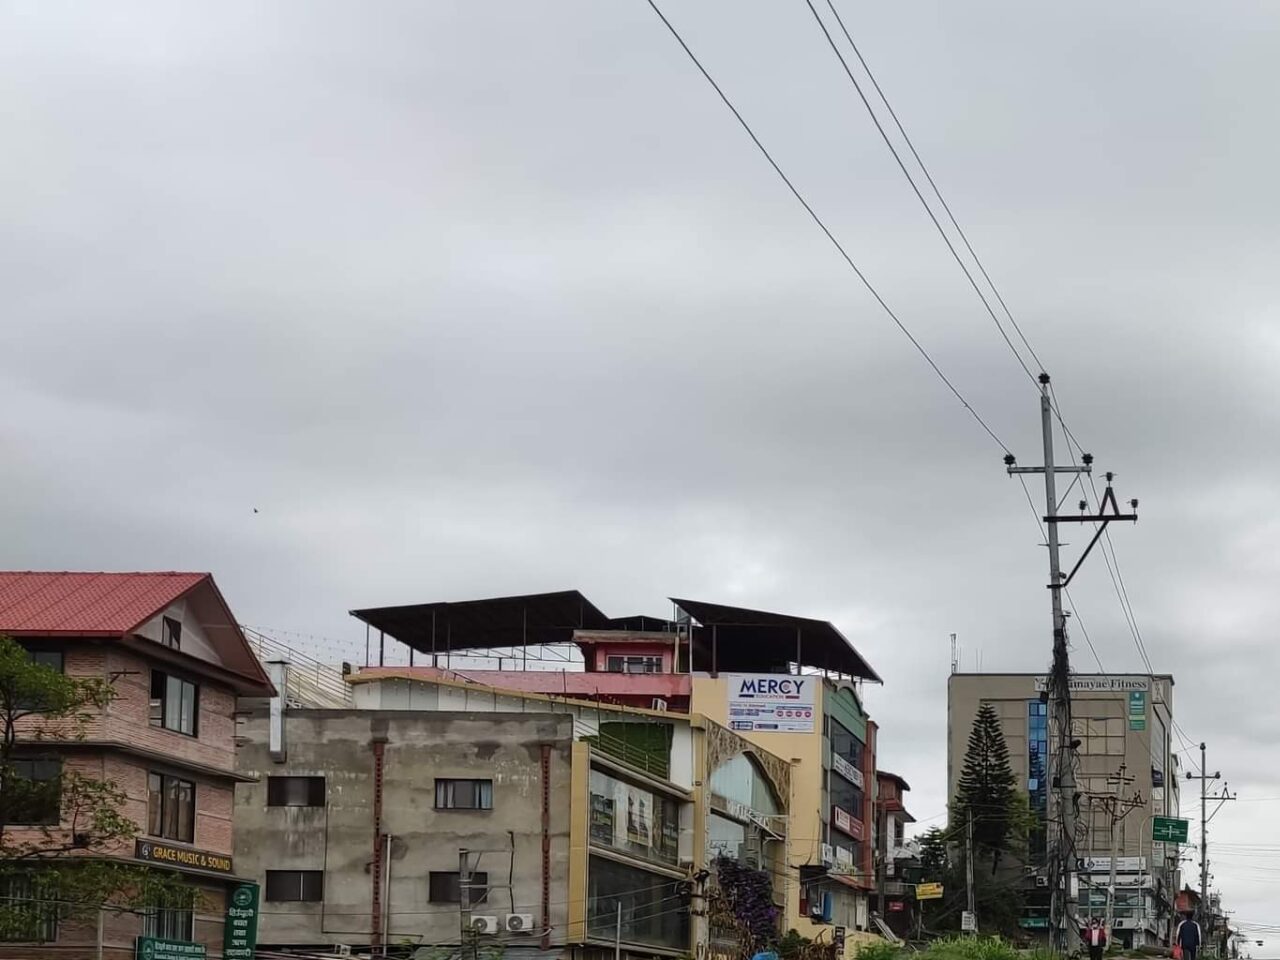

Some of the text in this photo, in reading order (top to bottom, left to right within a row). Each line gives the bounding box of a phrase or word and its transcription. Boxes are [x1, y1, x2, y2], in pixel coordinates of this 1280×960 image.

[740, 679, 804, 694] MERCY
[1110, 679, 1147, 688] Fitness
[153, 846, 231, 871] GRACE MUSIC & SOUND
